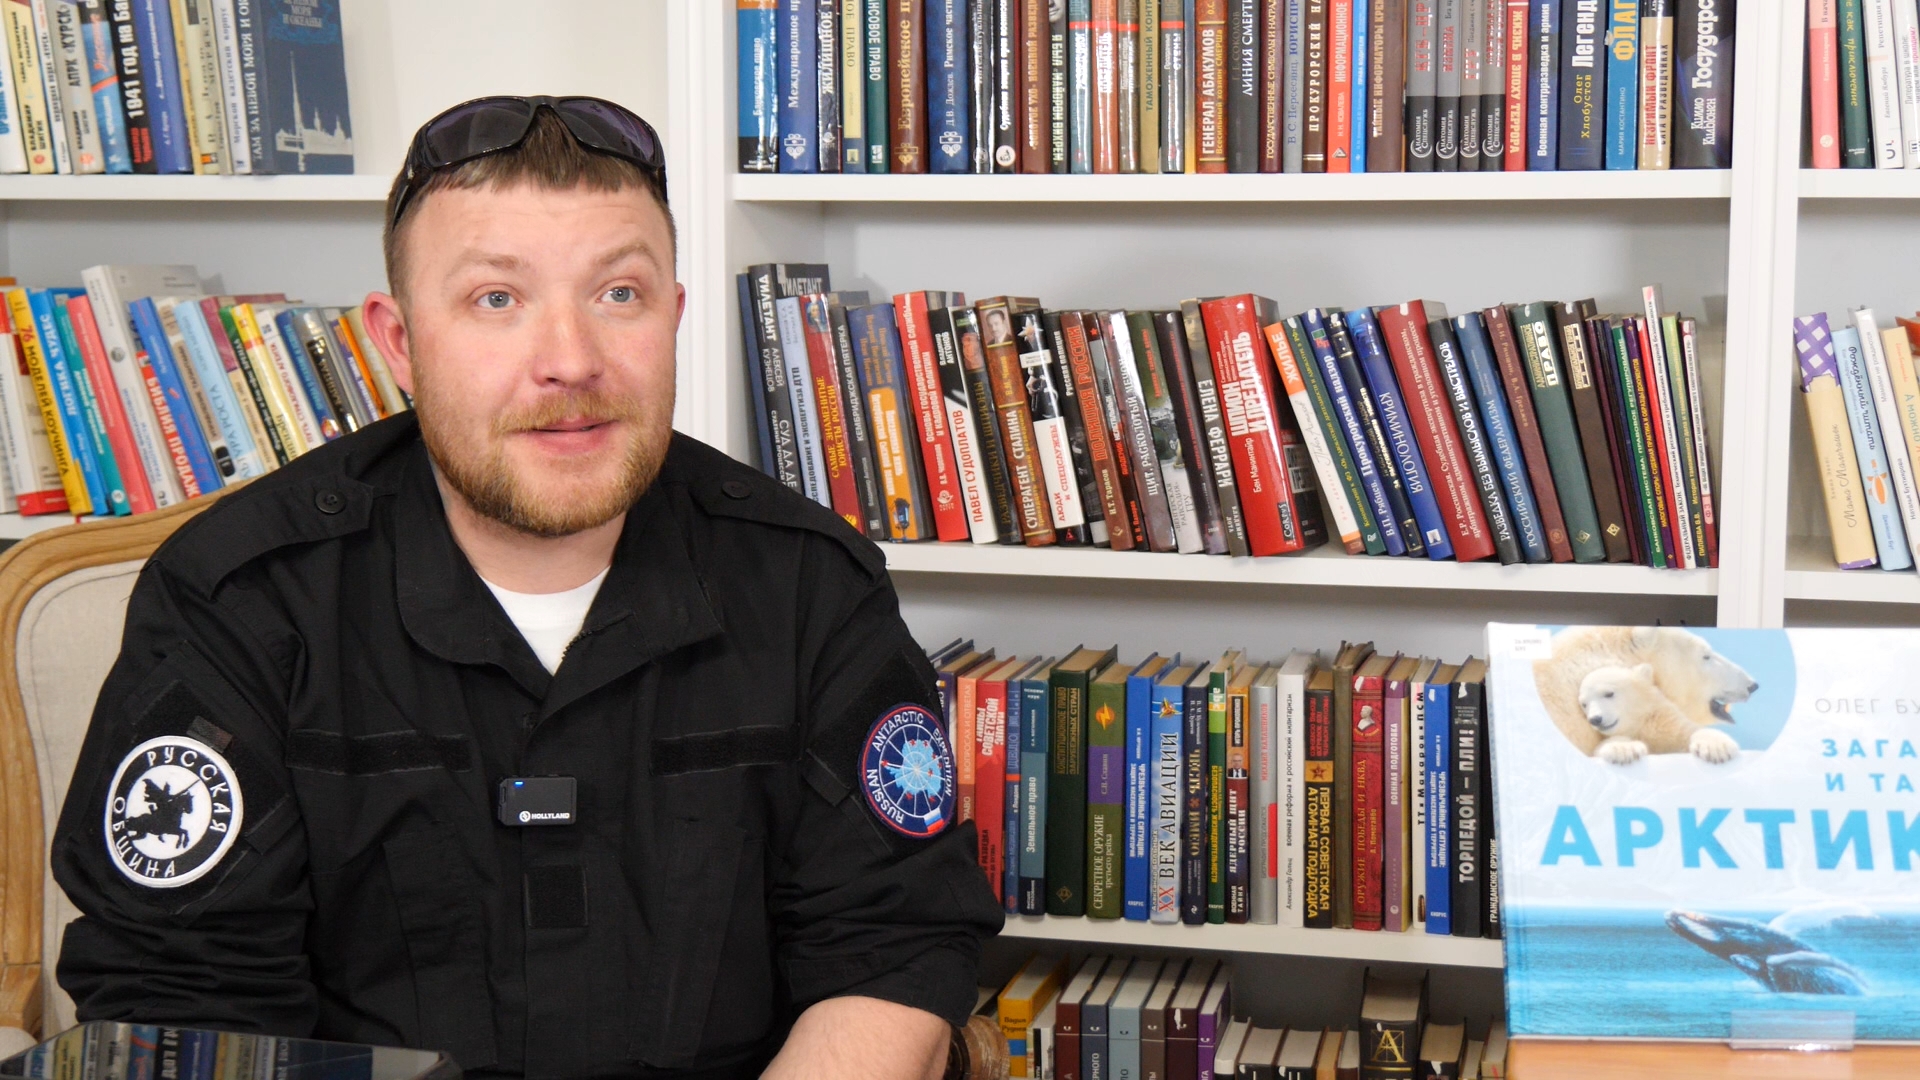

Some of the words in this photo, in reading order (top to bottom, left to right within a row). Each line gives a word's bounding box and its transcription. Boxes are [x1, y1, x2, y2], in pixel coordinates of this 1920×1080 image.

[56, 4, 76, 53] «КУРСК»
[117, 24, 131, 43] на
[1512, 11, 1522, 50] ЖИЗНЬ
[1540, 4, 1551, 33] армия
[1846, 11, 1854, 31] как
[65, 59, 81, 87] АПРК
[121, 46, 139, 74] год
[820, 11, 834, 94] ЖИЛИЩНОЕ
[897, 19, 914, 130] Европейское
[1202, 30, 1214, 96] АБАКУМОВ
[1242, 48, 1253, 96] ЛИНИЯ
[1511, 53, 1521, 61] В
[1844, 38, 1858, 106] приключение
[124, 80, 144, 119] 1941
[1308, 22, 1321, 131] ПРОКУРОРСКИЙ
[1511, 64, 1521, 100] ЭПОХУ
[1538, 44, 1551, 115] контрразведка
[1574, 74, 1584, 104] Олег
[1202, 101, 1215, 154] ГЕНЕРАЛ
[1509, 103, 1521, 154] ТЕРРОРА
[1581, 74, 1593, 138] Хлобустов
[1536, 117, 1549, 157] Военная
[38, 313, 59, 359] ЧУДЕС
[269, 342, 285, 370] АГЕНТА
[837, 324, 852, 366] ПЯТЕРКА
[941, 331, 955, 364] АНТОНОВ
[1053, 330, 1067, 364] полиция
[1067, 325, 1091, 383] РОССИИ
[1271, 331, 1299, 384] ЖИЛЬЕ
[1407, 320, 1425, 356] процессе
[1522, 324, 1546, 388] АДМИНИСТРАТИВНОЕ
[1536, 320, 1559, 386] ПРАВО
[54, 360, 77, 416] ЛОГИКА
[763, 348, 775, 392] КУЗНЕЦОВ
[771, 347, 784, 387] АЛЕКСЕЙ
[1061, 364, 1074, 396] Русская
[1231, 331, 1267, 419] ПРЕДАТЕЛЬ
[1322, 354, 1345, 393] надзор
[1419, 356, 1440, 399] уголовном
[1438, 341, 1467, 401] ВЫСТРЕЛОВ
[1617, 338, 1636, 408] РЕГУЛИРОВАНИЕ
[282, 370, 305, 420] СТРАХОВОГО
[815, 375, 835, 441] ЗНАМЕНИТЫЕ
[826, 384, 841, 423] РОССИИ
[844, 366, 864, 442] КЕМБРИДЖСКАЯ
[974, 381, 995, 438] ШПИОНЫ
[1222, 382, 1249, 436] ШПИОН
[1459, 402, 1469, 411] И
[145, 376, 176, 433] БИБЛИЯ
[170, 435, 200, 497] ПРОДАЖ
[302, 421, 313, 443] ПУТЬ
[833, 425, 847, 467] ЮРИСТЫ
[952, 409, 975, 482] СУДОПЛАТОВ
[986, 439, 996, 448] И
[1005, 410, 1024, 460] СТАЛИНА
[1080, 389, 1108, 462] ПОЛИЦИЯ
[1198, 379, 1218, 424] ЕЛЕНА
[1208, 427, 1233, 488] ФЕРРАРИ
[1252, 419, 1268, 433] И
[1339, 395, 1372, 477] Прокурорский
[1378, 391, 1424, 494] КРИМИНОЛОГИЯ
[1437, 405, 1465, 482] административном
[1462, 412, 1487, 472] ВЫМЫСЛОВ
[1487, 399, 1515, 470] ФЕДЕРАЛИЗМ
[1630, 409, 1644, 454] ПРАВОВОЕ
[829, 443, 840, 479] САМЫЕ
[1244, 437, 1260, 478] Макинтайр
[1639, 455, 1653, 496] СИСТЕМА:
[968, 484, 984, 523] ПАВЕЛ
[988, 451, 1011, 524] РАЗВЕДЧИКИ
[1015, 465, 1038, 529] СУПЕРАГЕНТ
[1101, 468, 1114, 500] Тарасов
[1183, 494, 1194, 513] ГРУ
[1253, 478, 1262, 493] Бен
[1371, 478, 1388, 516] Рябцев.
[1480, 473, 1494, 490] БЕЗ
[1054, 492, 1066, 522] ЛЮДИ
[1107, 500, 1118, 516] Н.Т.
[1383, 516, 1396, 537] В.П.
[1463, 483, 1481, 539] арбитражном,
[1486, 491, 1511, 541] РАЗВЕДКА
[1508, 471, 1538, 548] РОССИЙСКИЙ
[1645, 498, 1661, 553] БАНКОВСКАЯ
[963, 684, 972, 720] ОТВЕТАХ
[1056, 687, 1067, 709] ПРАВО
[1069, 687, 1078, 715] СТРАН
[1814, 698, 1880, 715] ОЛЕГ
[872, 711, 924, 752] ANTARCTIC
[982, 698, 1000, 756] СОВЕТСКОЙ
[1054, 710, 1067, 774] КОНСТИТУЦИОННОЕ
[1069, 716, 1078, 775] ЗАРУБЕЖНЫХ
[1260, 702, 1269, 750] КАЛАШНИКОВ
[1390, 723, 1398, 770] ПОДГОТОВКА
[1820, 738, 1918, 759] ЗАГА
[932, 728, 952, 797] EXPEDITION
[963, 731, 972, 772] ВОПРОСАХ
[1190, 748, 1202, 794] ЧЕСТЬ
[1260, 751, 1269, 781] МИХАИЛ
[1357, 758, 1366, 789] НКВД
[1458, 729, 1474, 772] ПЛИ!
[147, 747, 231, 833] РУССКАЯ
[866, 769, 905, 824] RUSSIAN
[1026, 776, 1038, 804] право
[1160, 731, 1180, 835] АВИАЦИИ
[1228, 788, 1238, 815] ЩИТ
[1357, 794, 1365, 802] И
[1390, 771, 1398, 805] ВОЕННАЯ
[1825, 773, 1846, 793] И
[1868, 773, 1915, 793] ТА
[1025, 805, 1037, 853] Земельное
[1190, 810, 1201, 856] ИМЕЮ
[1238, 809, 1246, 853] РОССИИ
[1307, 786, 1318, 848] АТОМНАЯ
[1319, 786, 1329, 835] ПЕРВАЯ
[1356, 806, 1366, 851] ПОБЕДЫ
[112, 796, 175, 877] ОБЩИНА
[1093, 814, 1104, 854] ОРУЖИЕ
[1104, 833, 1114, 856] рейха
[1228, 818, 1238, 874] ЯДЕРНЫЙ
[1456, 793, 1475, 883] ТОРПЕДОЙ
[1539, 804, 1920, 872] АРКТИК
[1093, 855, 1104, 910] СЕКРЕТНОЕ
[1104, 857, 1114, 889] третьего
[1159, 840, 1176, 879] ВЕК
[1319, 836, 1329, 910] СОВЕТСКАЯ
[1357, 855, 1367, 904] ОРУЖИЕ
[1307, 850, 1317, 918] ПОДЛОДКА
[1489, 869, 1498, 923] ГРАЖДАНСКОЕ
